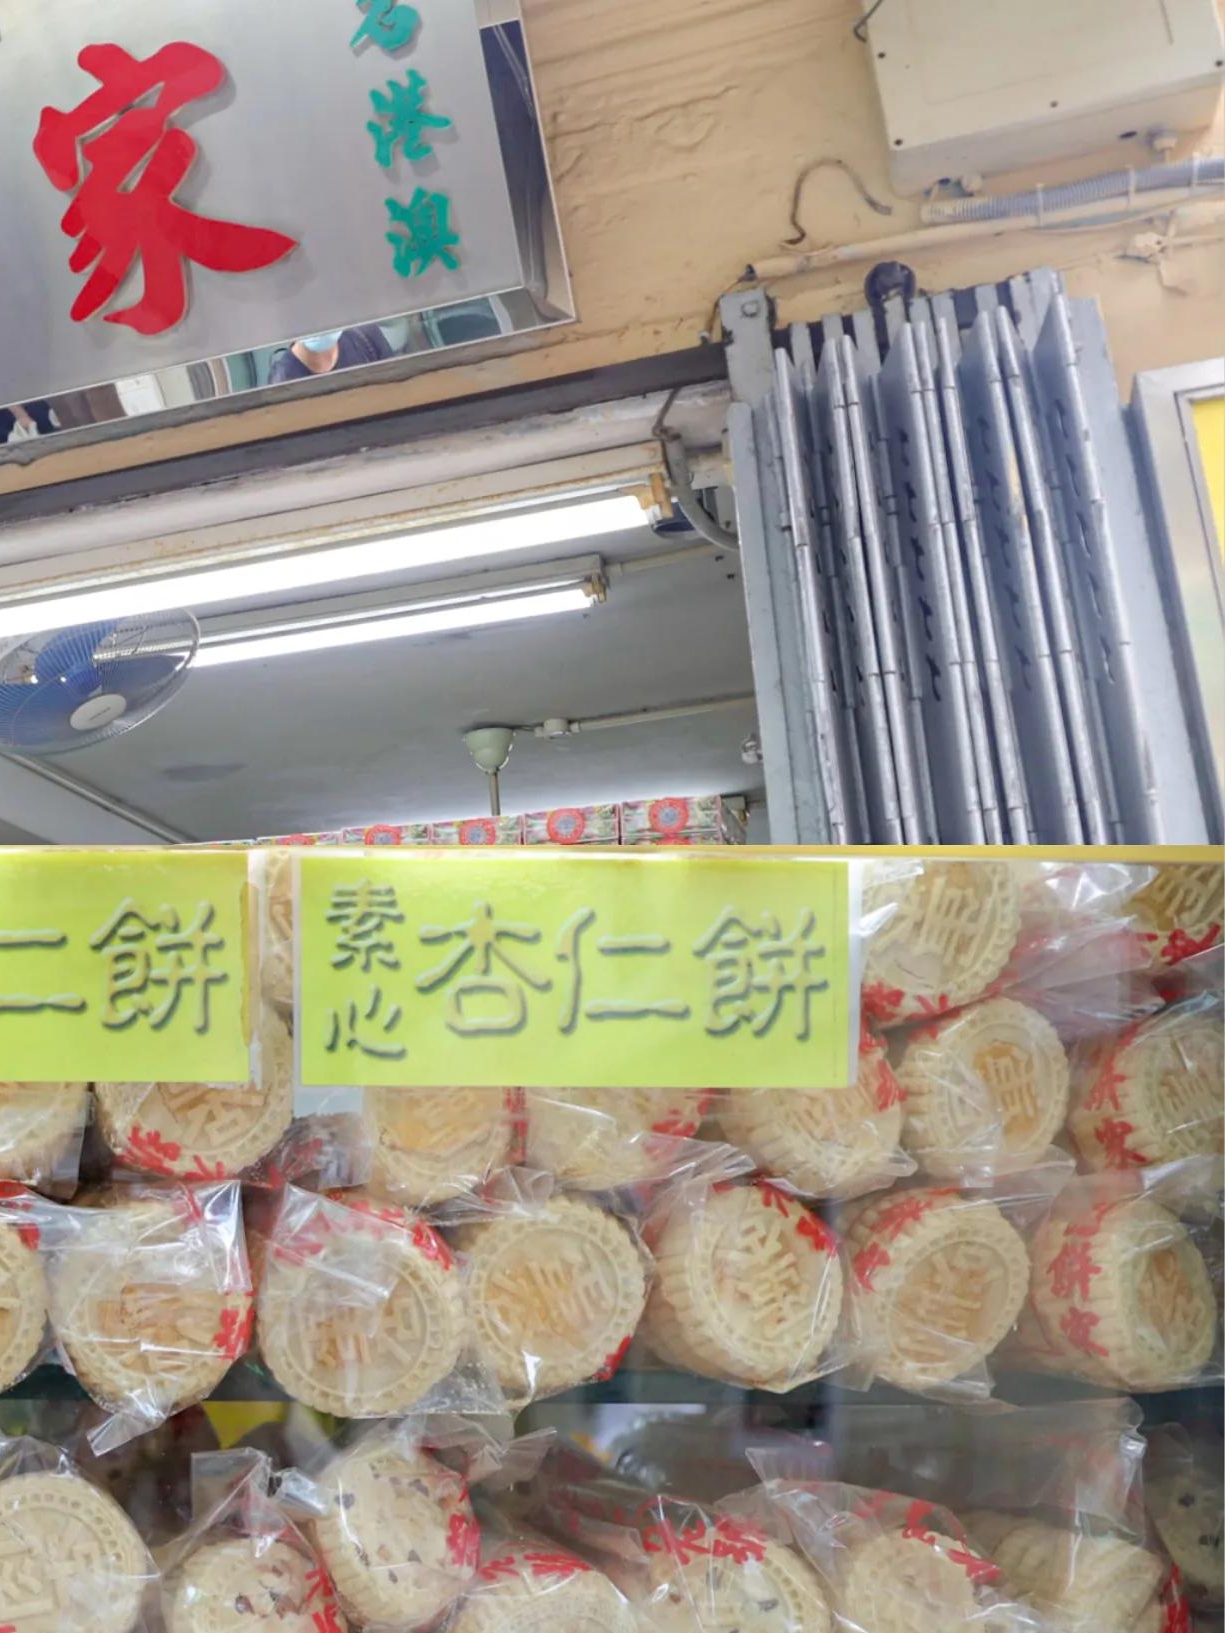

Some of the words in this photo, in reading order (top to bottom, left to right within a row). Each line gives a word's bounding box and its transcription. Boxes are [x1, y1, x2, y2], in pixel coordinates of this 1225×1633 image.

[325, 877, 407, 1061] 素心
[415, 902, 830, 1043] 杏仁餅
